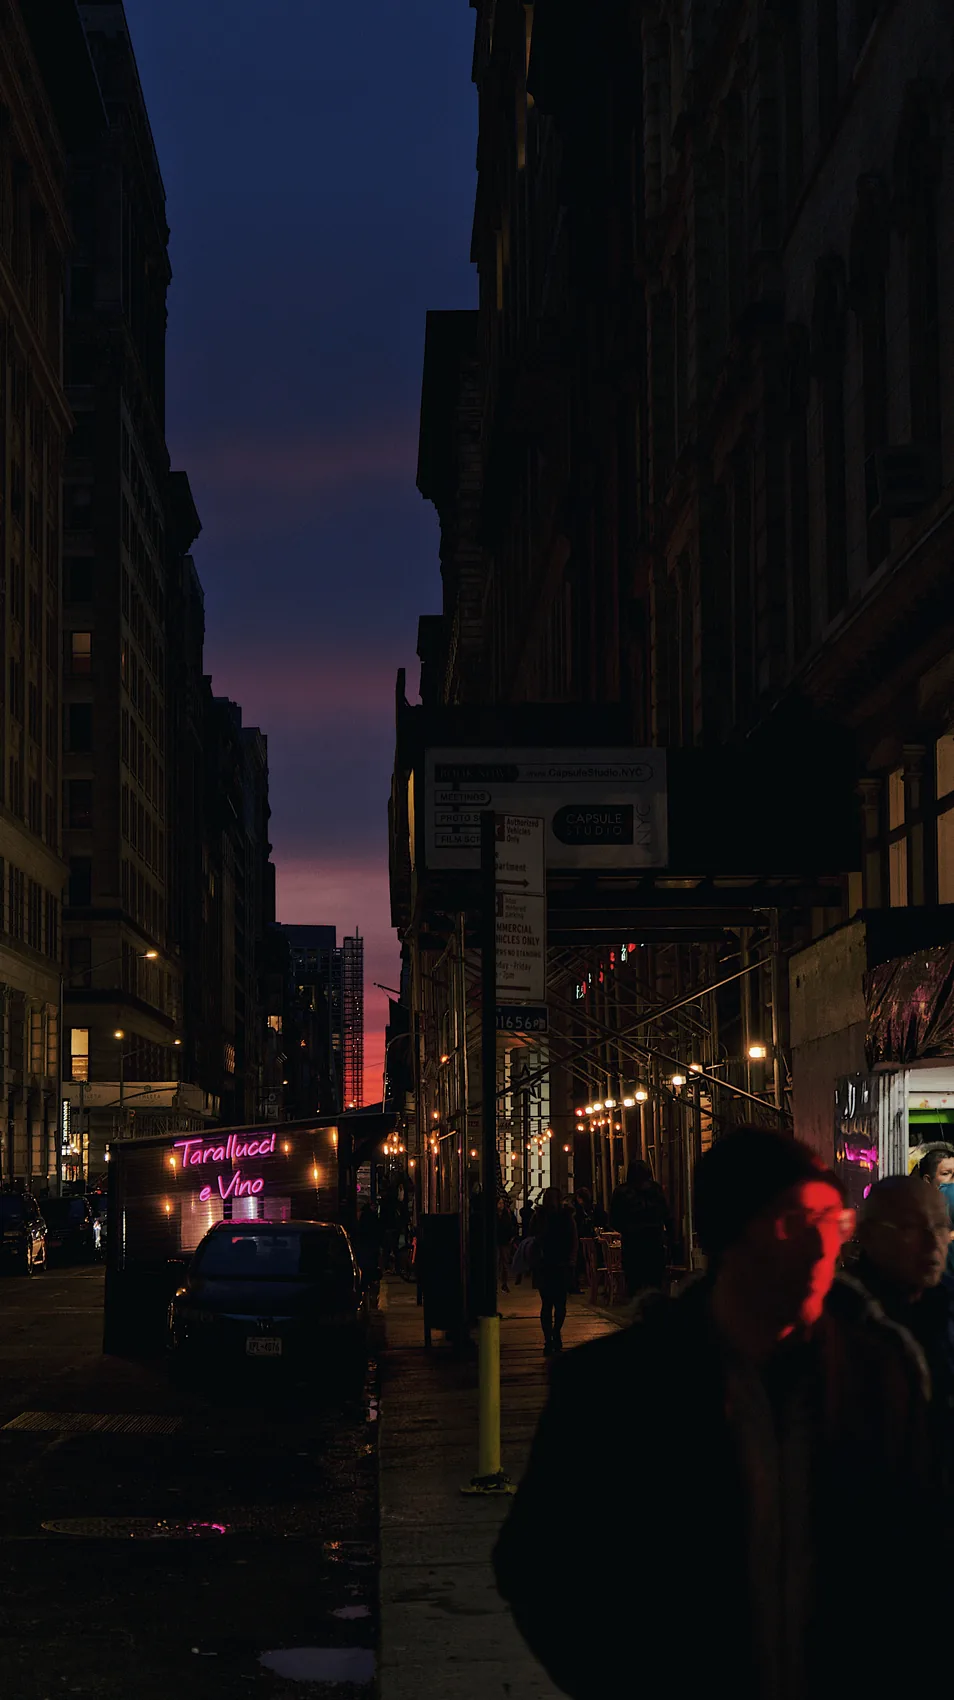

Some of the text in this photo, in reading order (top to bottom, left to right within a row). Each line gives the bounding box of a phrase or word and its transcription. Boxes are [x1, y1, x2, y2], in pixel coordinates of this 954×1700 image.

[440, 793, 485, 801] MEETINGS
[440, 814, 471, 822] PHOTO
[506, 817, 539, 828] Authorized
[565, 812, 624, 824] CAPSULE
[635, 803, 651, 846] NYC
[506, 826, 531, 836] Vehicles
[566, 825, 622, 836] STUDIO
[441, 835, 462, 843] FILM
[506, 834, 520, 844] Only
[495, 862, 527, 872] partment
[496, 922, 532, 934] MMERCIAL
[495, 934, 540, 947] HICLES ONLY
[173, 1132, 277, 1168] Tarallucci
[199, 1169, 265, 1202] e Vino
